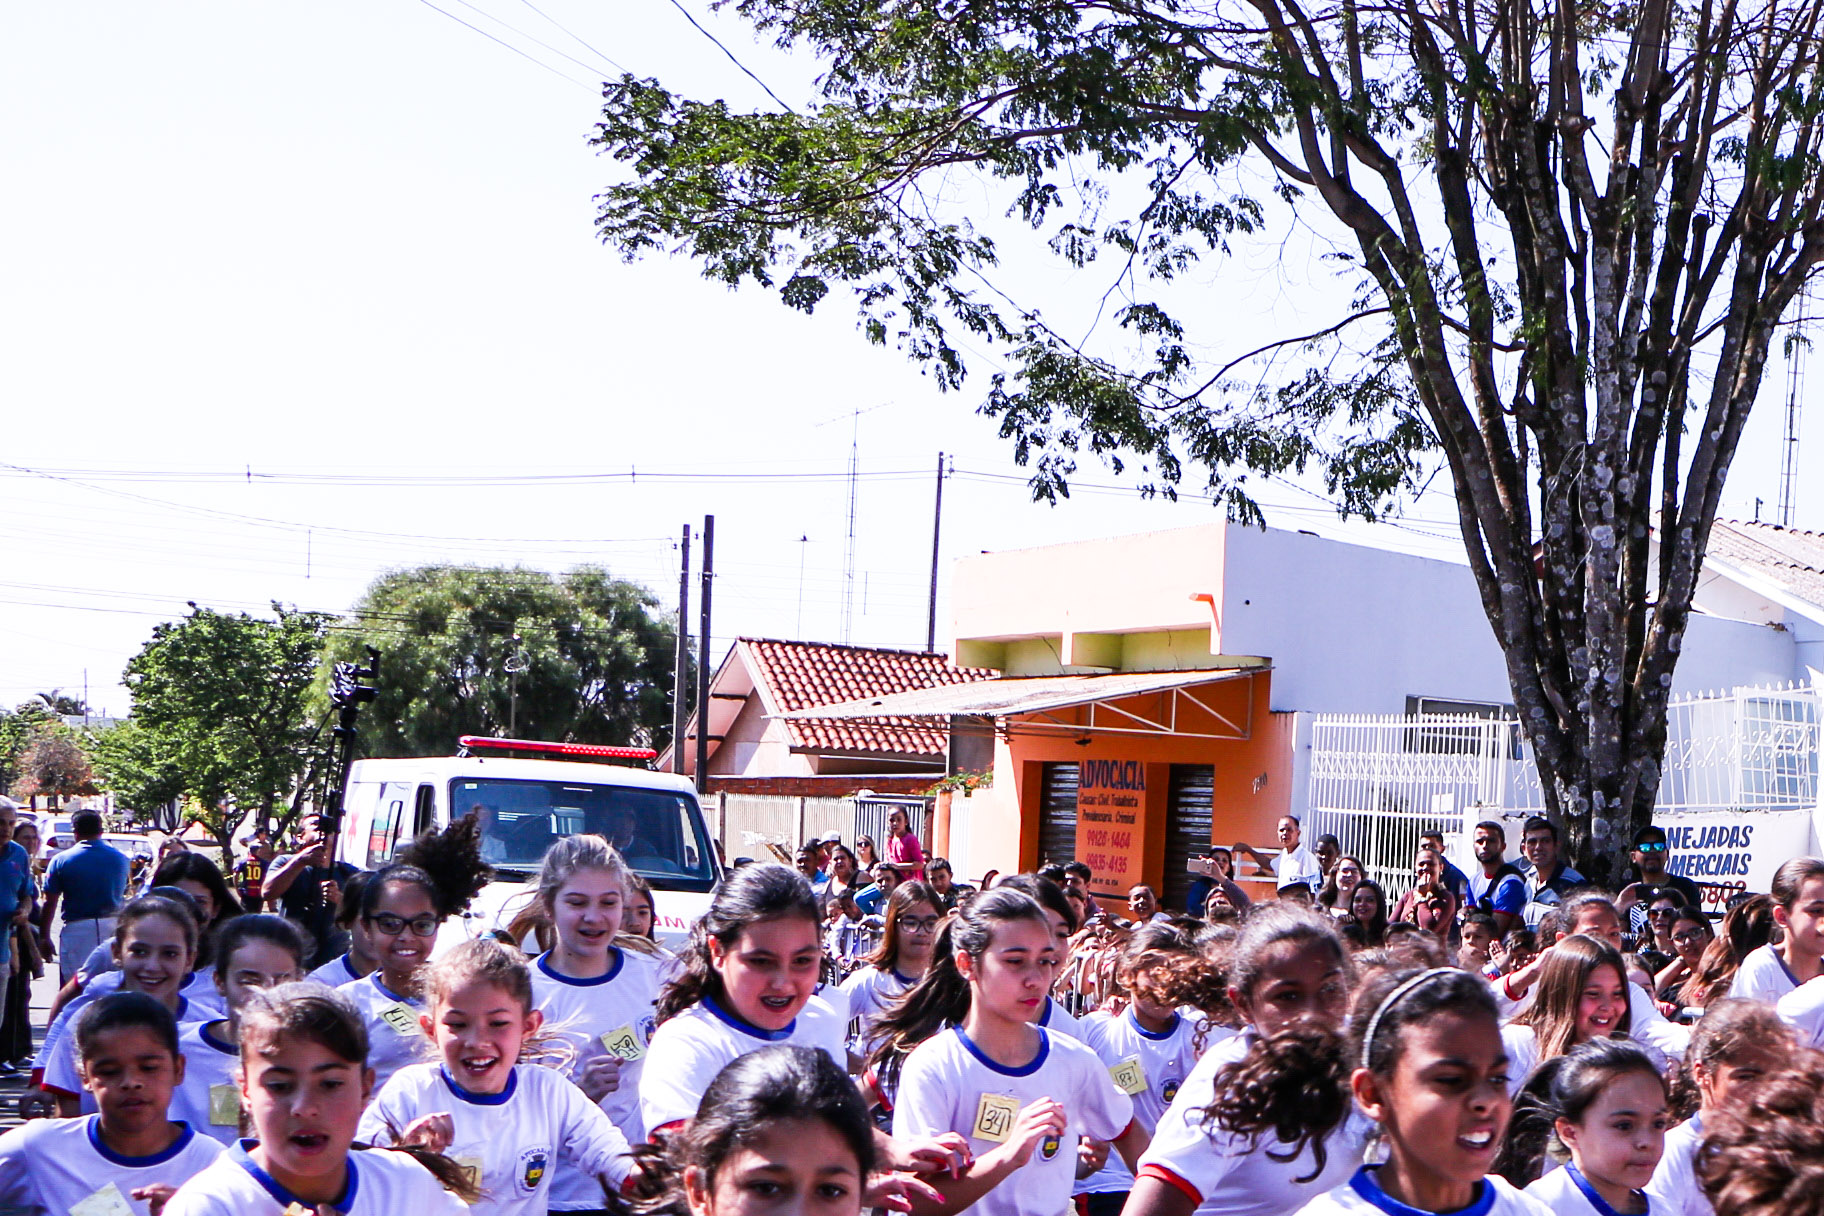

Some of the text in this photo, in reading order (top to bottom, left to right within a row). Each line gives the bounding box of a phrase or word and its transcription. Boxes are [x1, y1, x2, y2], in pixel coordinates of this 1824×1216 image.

[1079, 759, 1146, 791] ADVOCACIA
[1660, 825, 1754, 850] NEJADAS
[245, 865, 262, 881] 10
